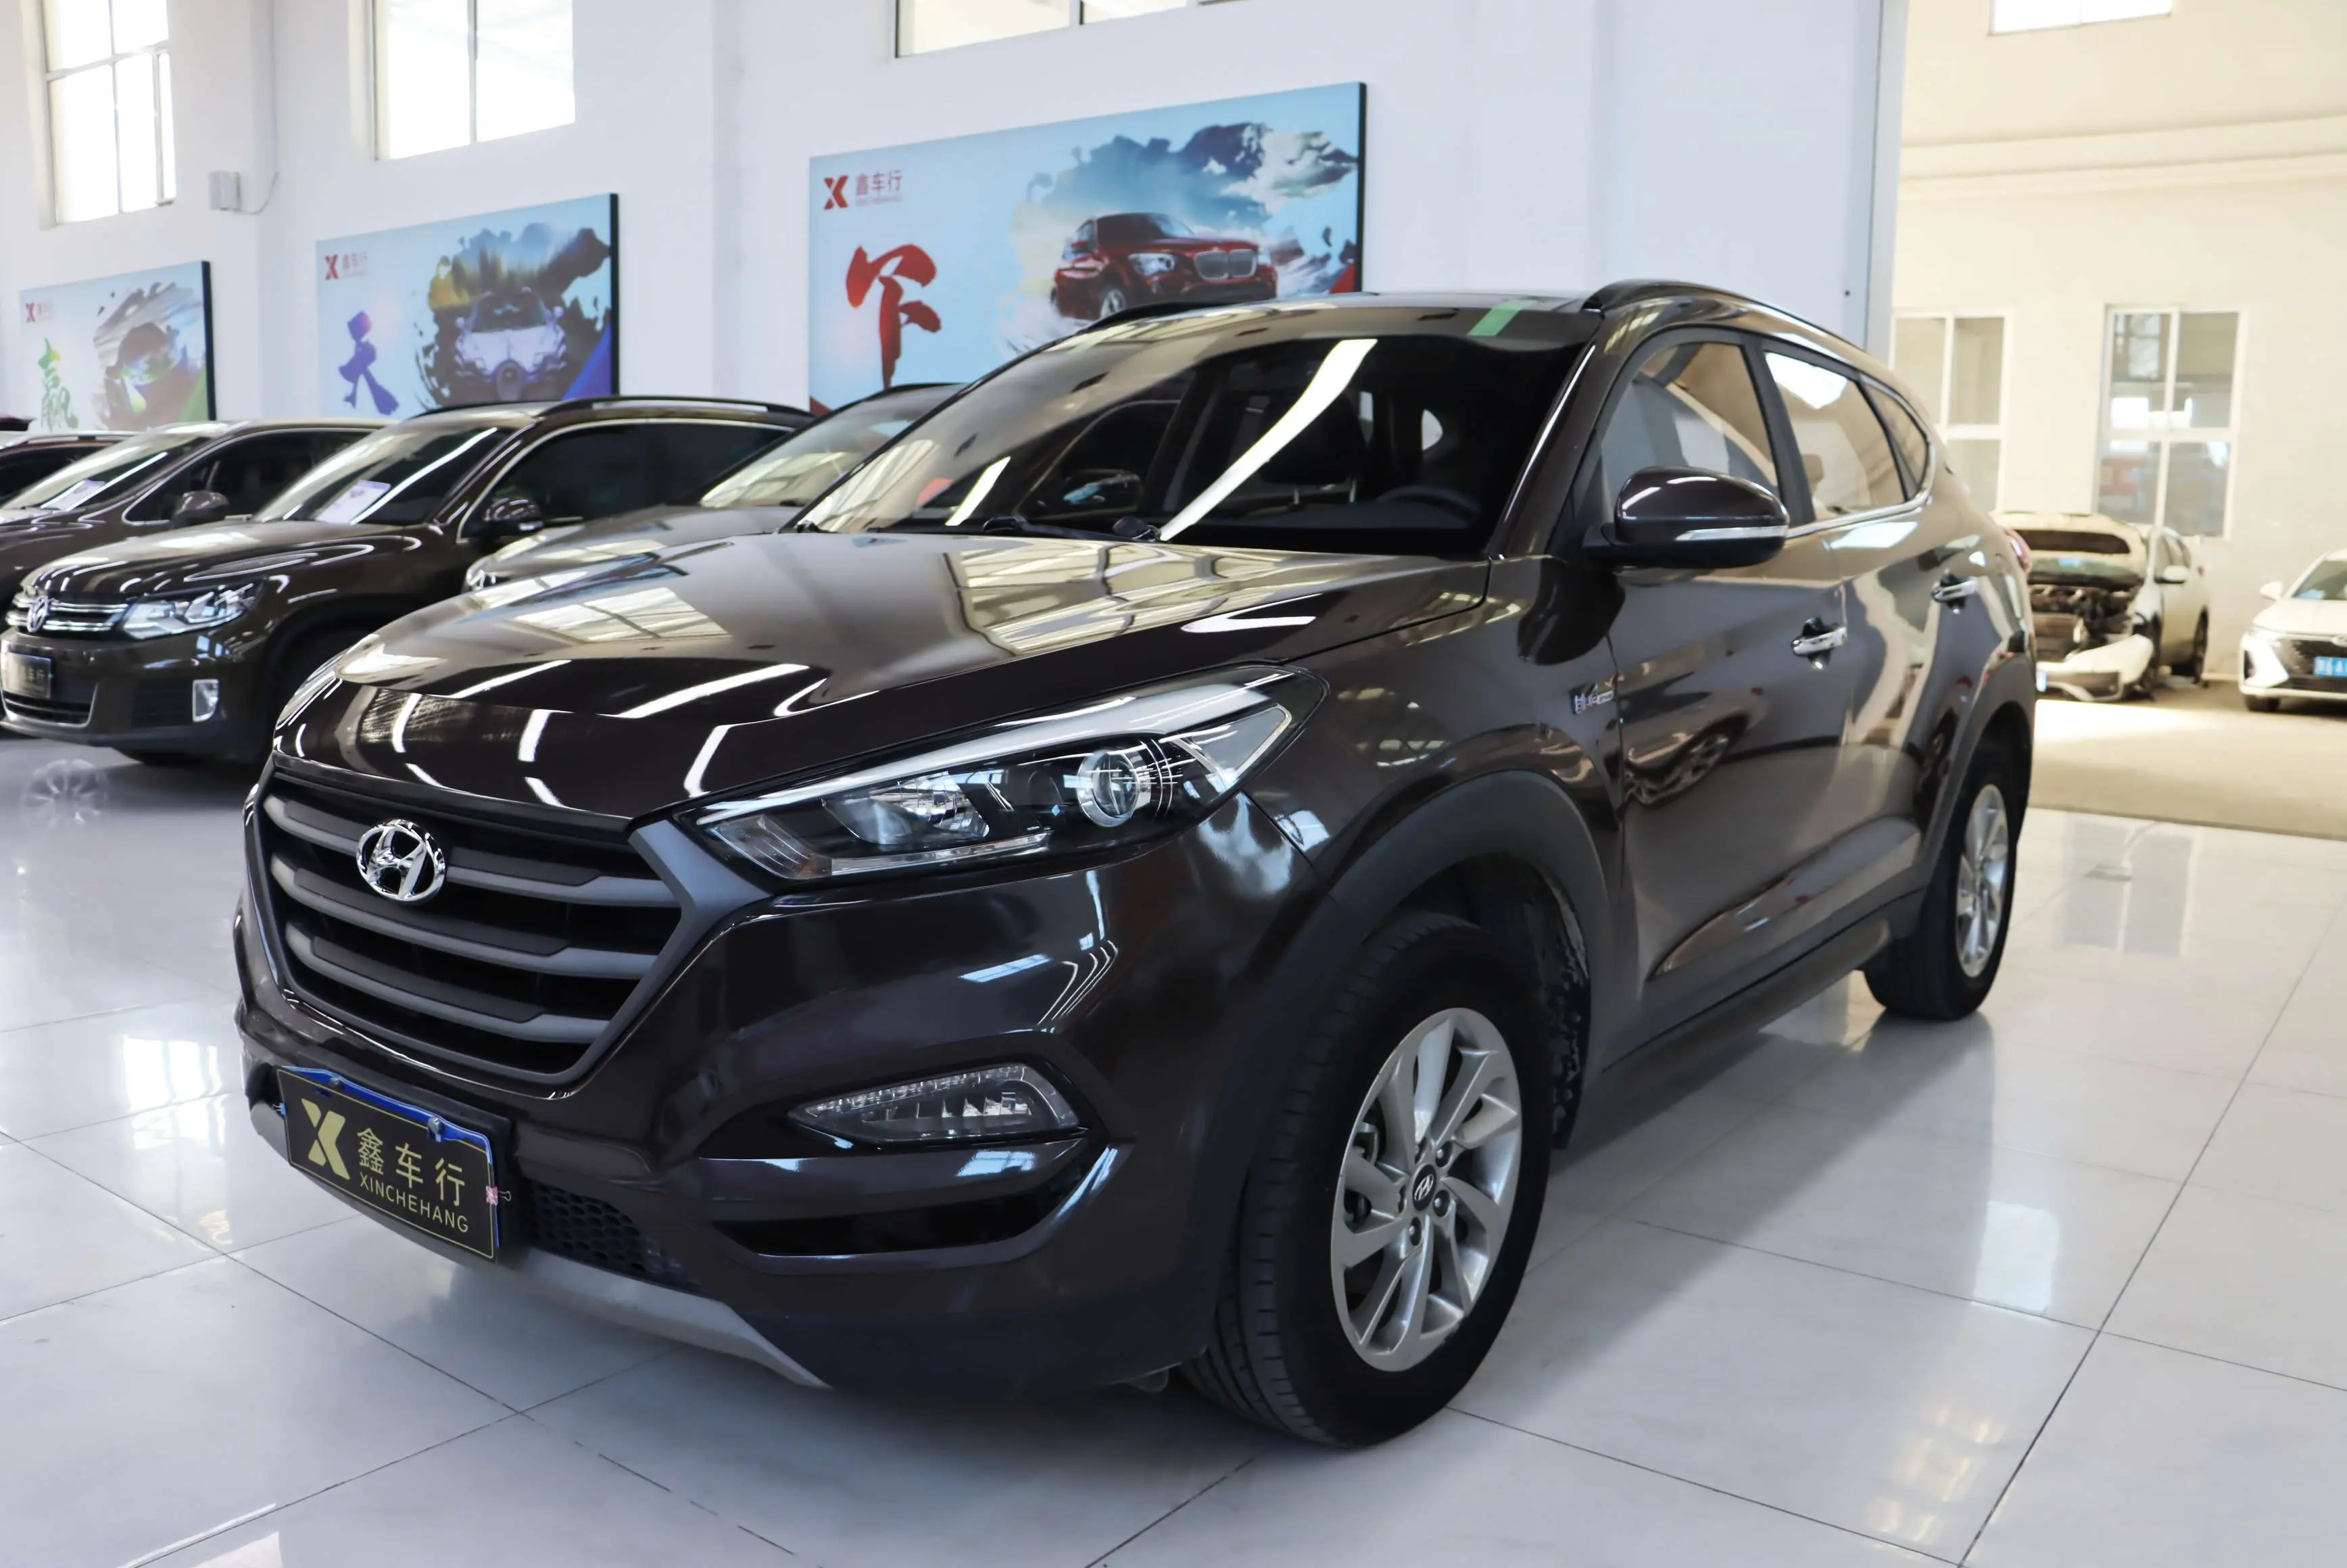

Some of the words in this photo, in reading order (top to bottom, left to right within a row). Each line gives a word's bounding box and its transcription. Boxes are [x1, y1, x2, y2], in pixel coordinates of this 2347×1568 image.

[356, 1127, 465, 1206] 鑫车行
[359, 1171, 469, 1233] XINCHEHANG
